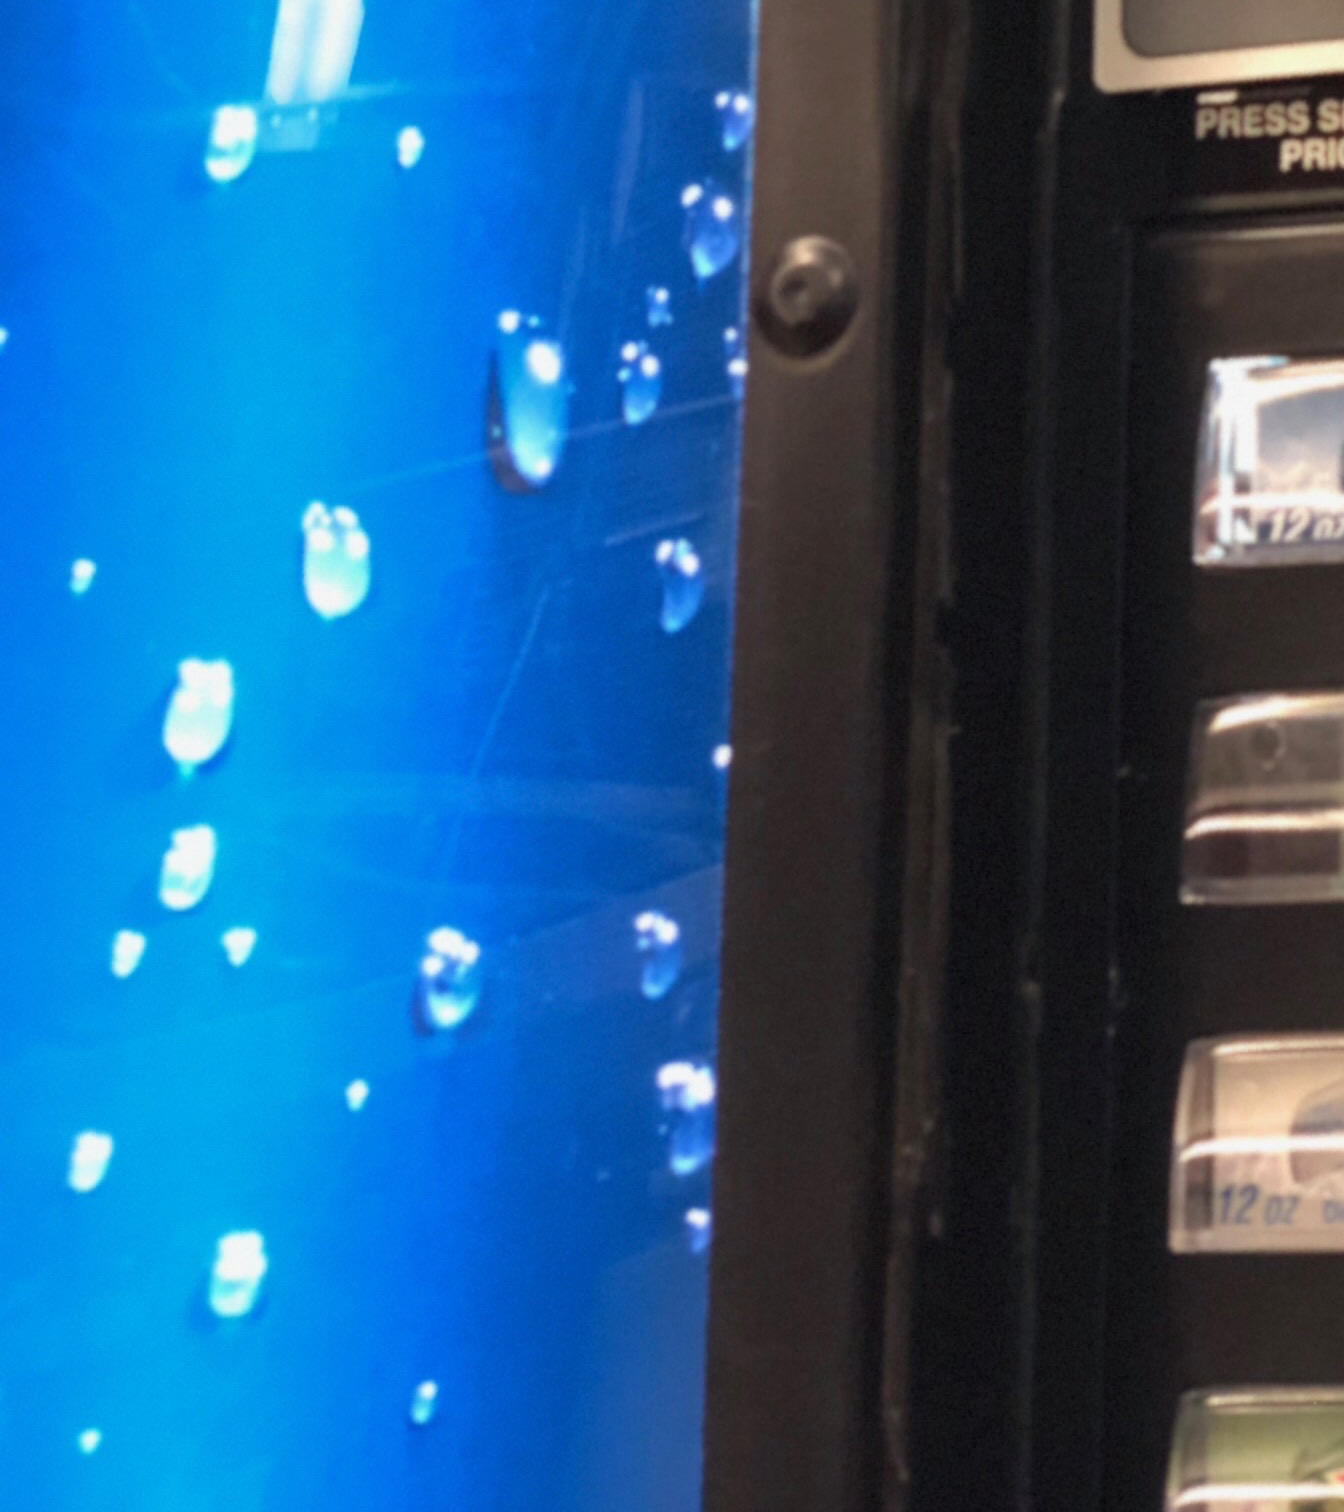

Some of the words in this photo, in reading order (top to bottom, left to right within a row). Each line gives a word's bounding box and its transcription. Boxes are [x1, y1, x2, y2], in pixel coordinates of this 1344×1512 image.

[1195, 100, 1310, 139] PRESS
[1268, 507, 1312, 544] 12
[1216, 1184, 1260, 1225] 12
